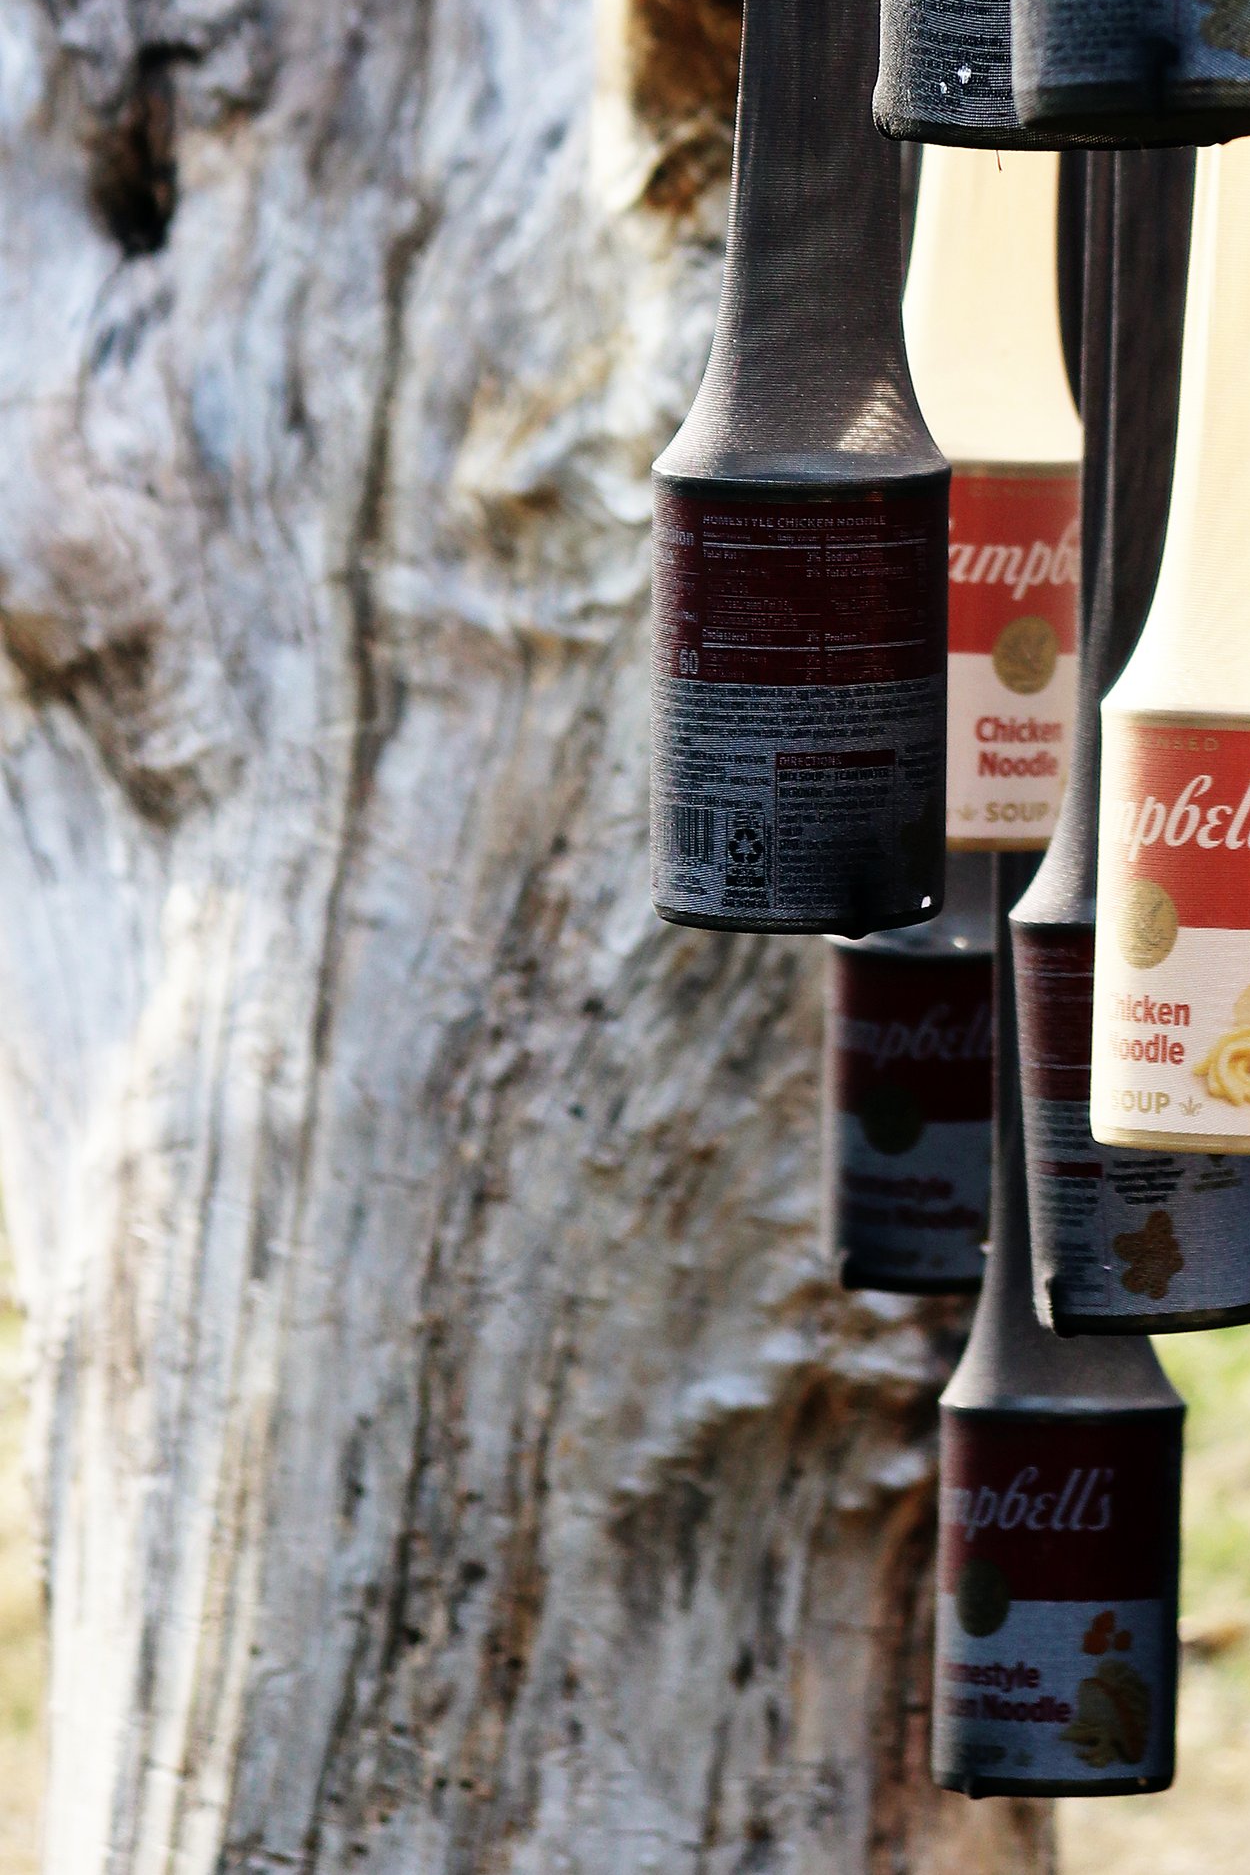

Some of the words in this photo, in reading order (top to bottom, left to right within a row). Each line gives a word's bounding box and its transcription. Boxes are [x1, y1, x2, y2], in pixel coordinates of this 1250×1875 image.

[776, 516, 834, 529] CHICKEN
[836, 515, 887, 527] NOODLE
[975, 716, 1063, 744] Chicken
[977, 751, 1059, 778] Noodle
[985, 802, 1049, 823] SOUP
[1113, 1033, 1186, 1066] oodle
